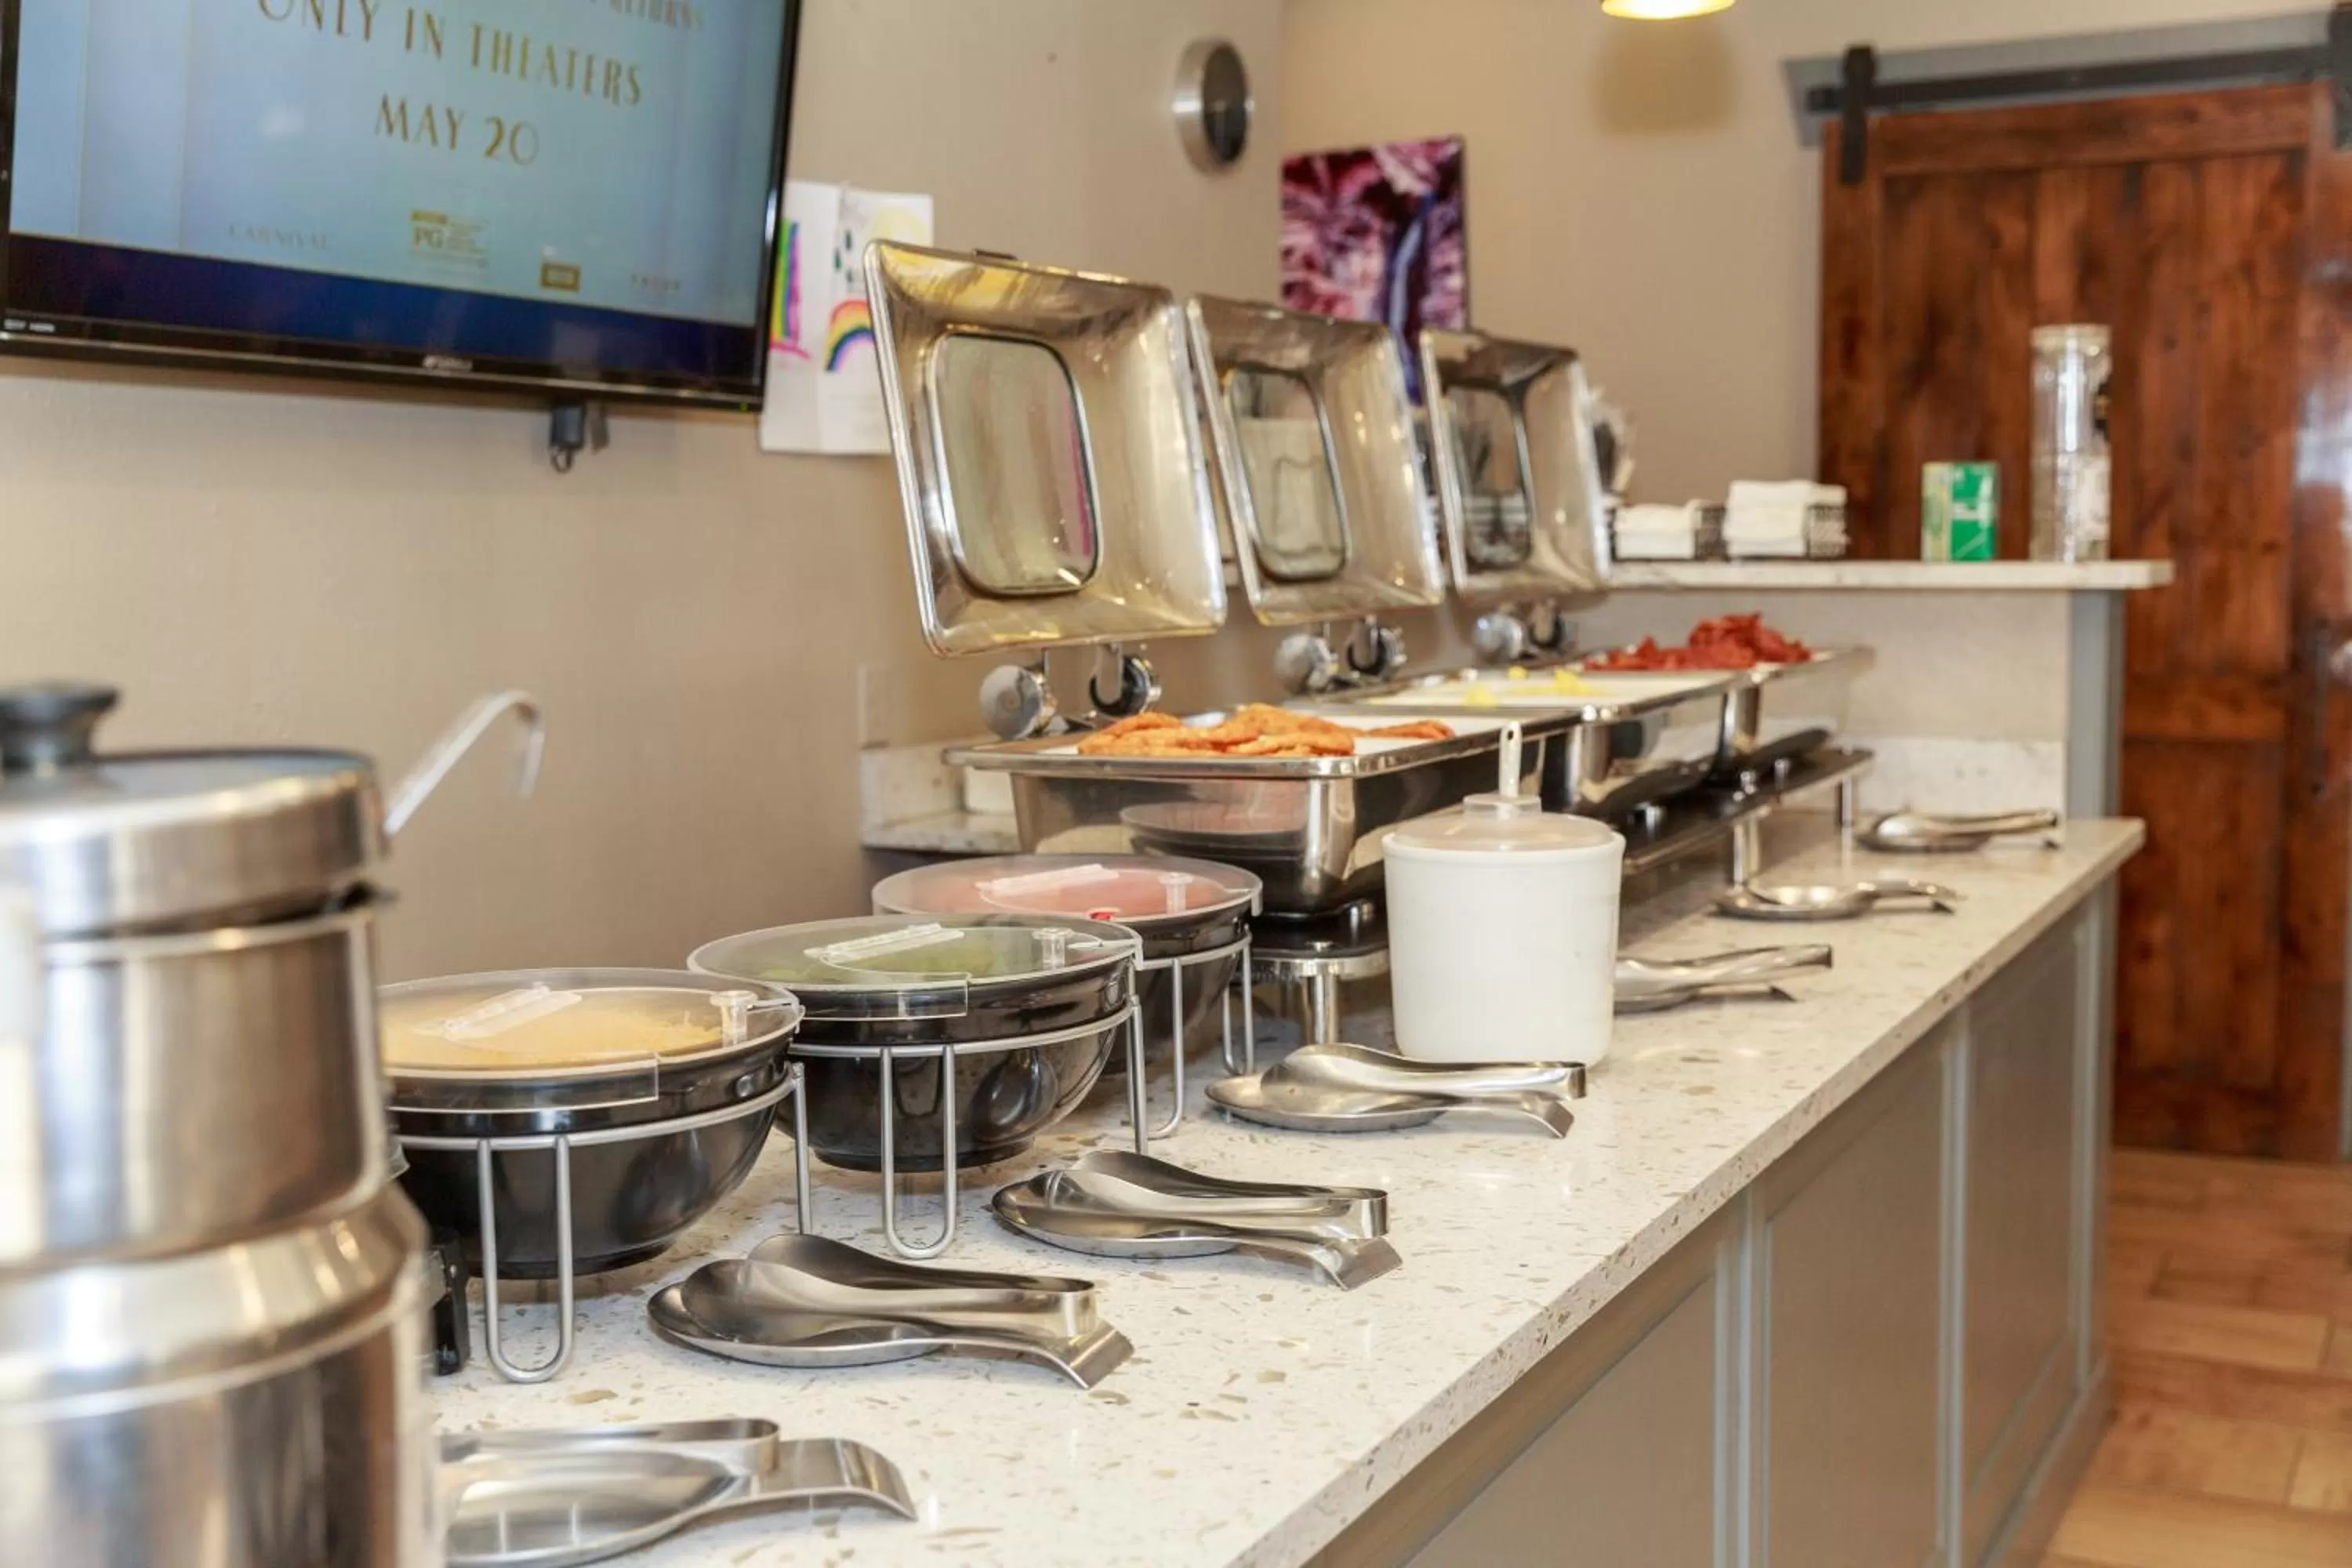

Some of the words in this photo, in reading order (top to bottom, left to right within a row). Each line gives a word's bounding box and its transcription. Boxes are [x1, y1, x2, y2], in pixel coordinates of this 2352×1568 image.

[402, 7, 444, 60] IN
[472, 24, 641, 107] THEATERS
[374, 91, 465, 151] MAY
[483, 115, 540, 166] 20
